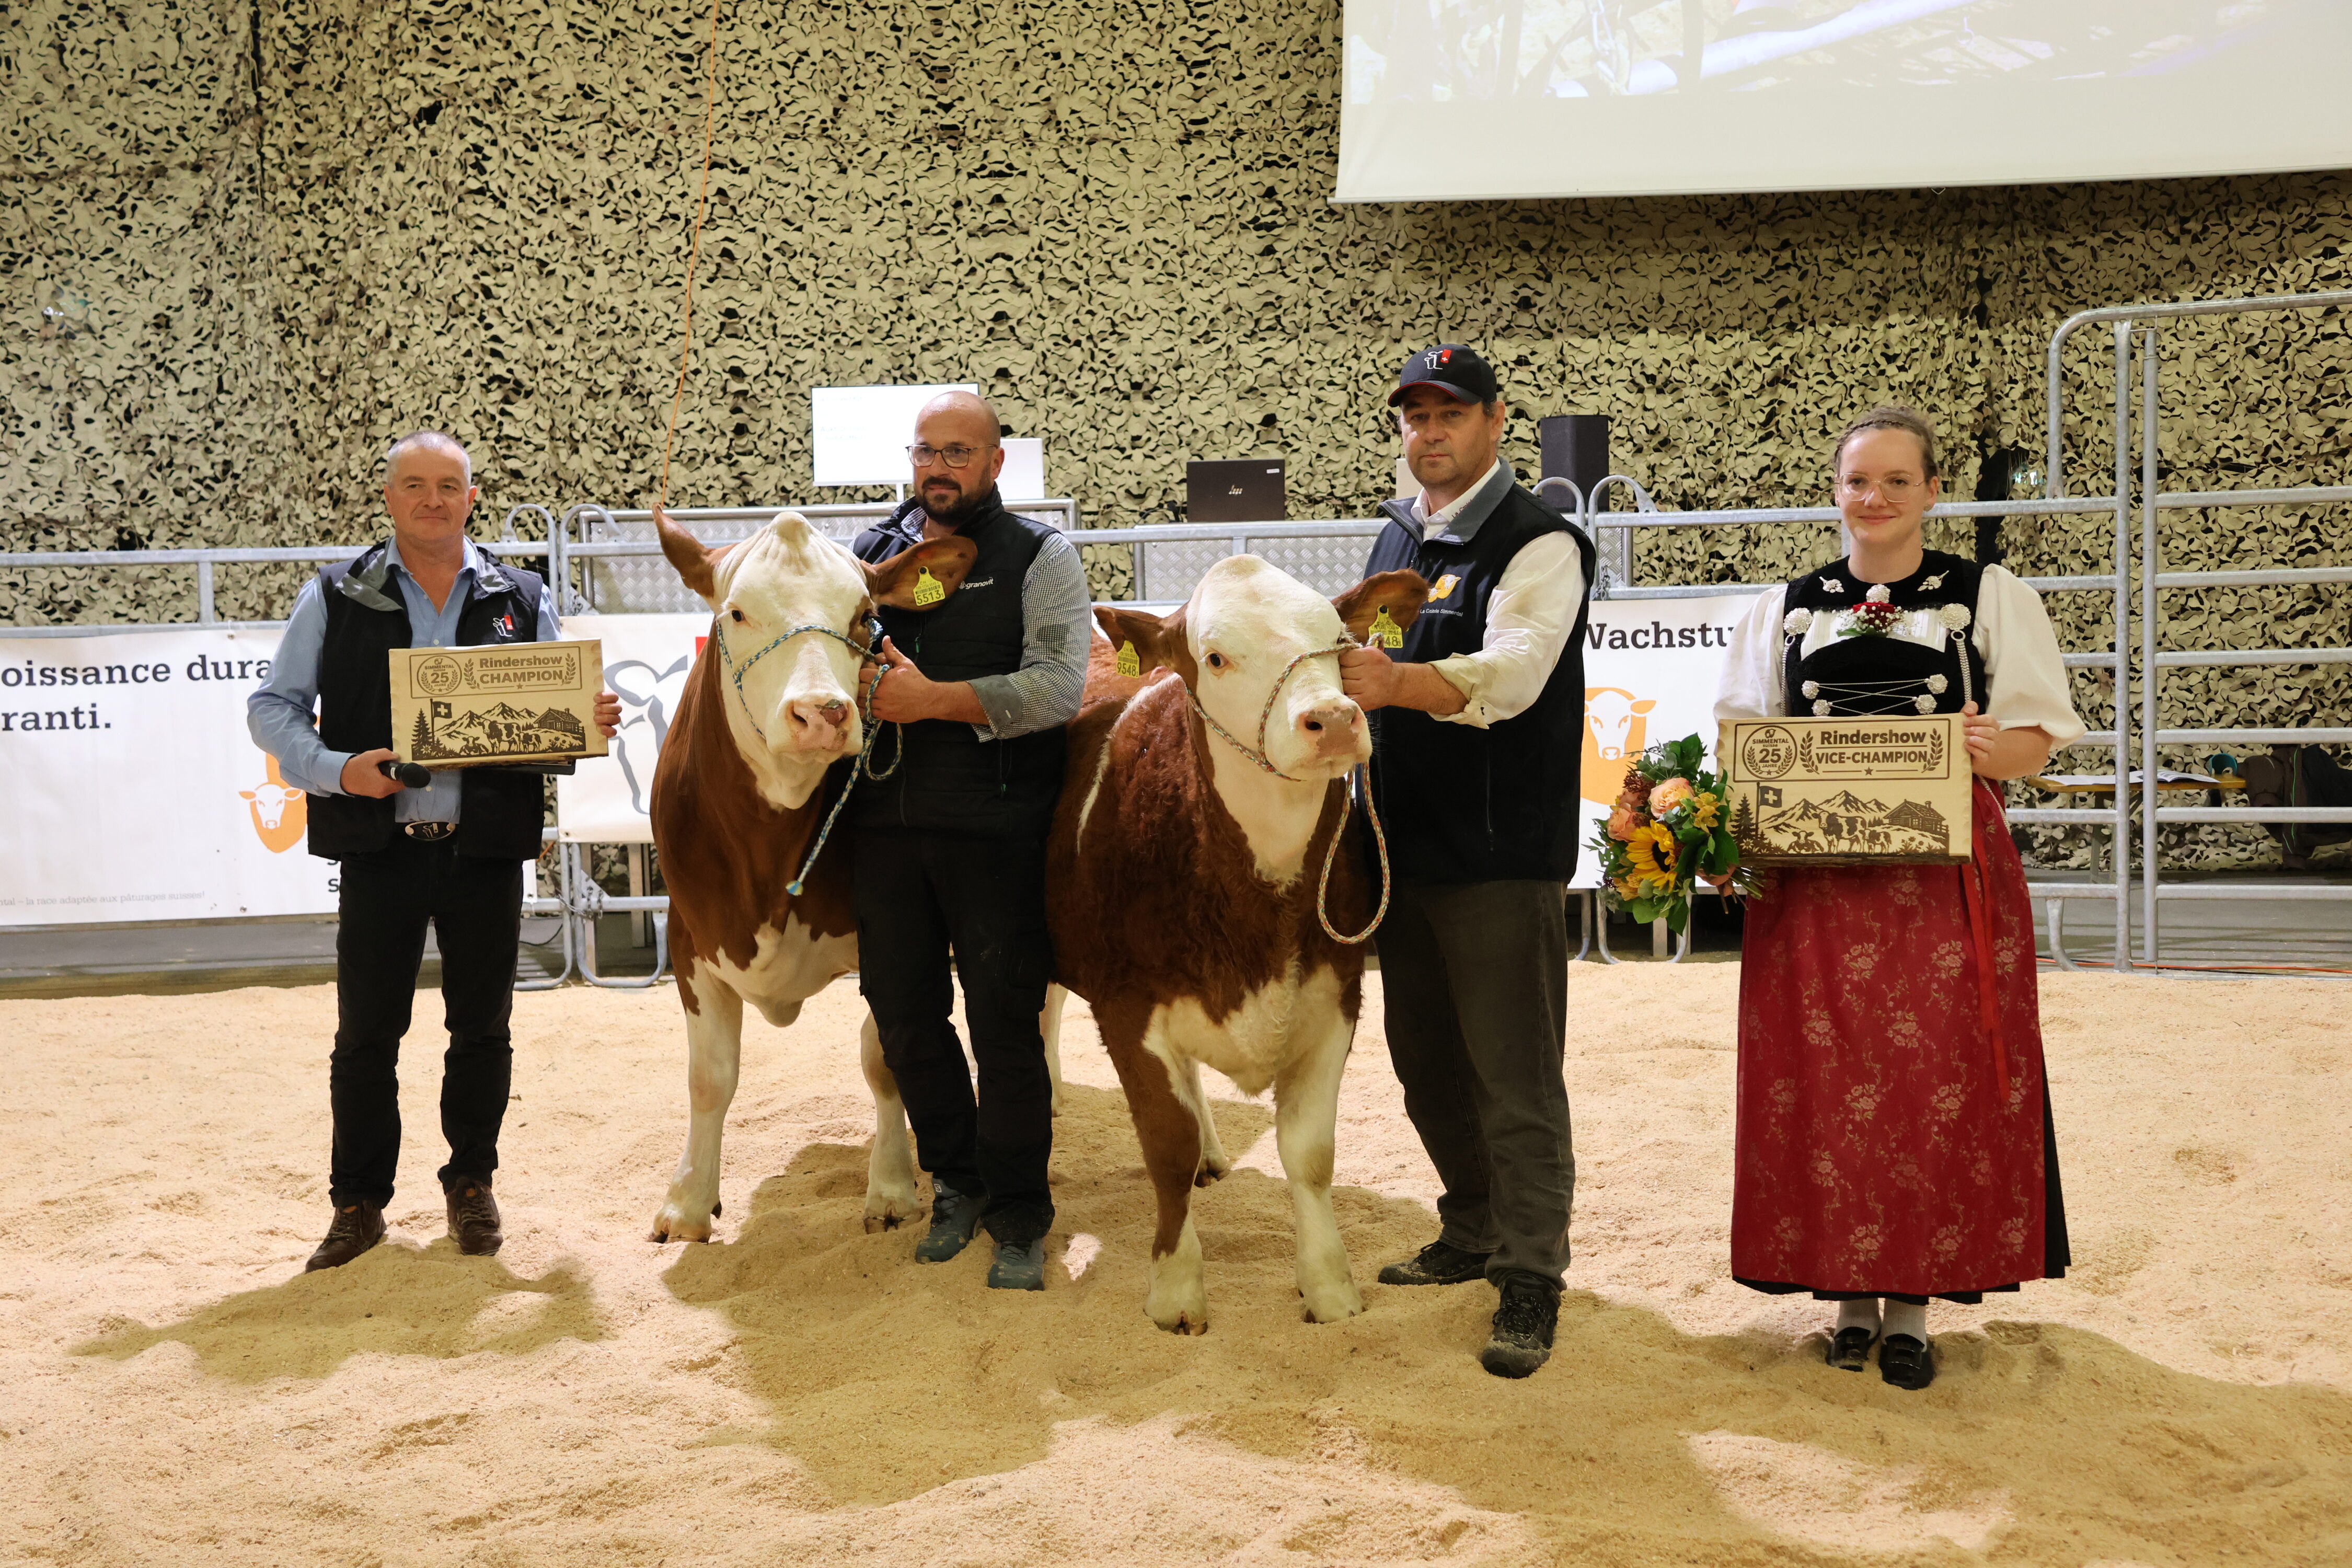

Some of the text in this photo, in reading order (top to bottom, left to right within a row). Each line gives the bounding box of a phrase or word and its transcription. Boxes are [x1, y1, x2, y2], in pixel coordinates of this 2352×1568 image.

[965, 577, 994, 590] granovit
[917, 590, 941, 604] 5513
[1439, 608, 1463, 617] Simmental
[479, 655, 562, 668] Rindershow
[1, 660, 171, 687] oissance
[1117, 662, 1136, 676] 9548
[431, 672, 449, 684] 25
[479, 670, 563, 684] CHAMPION
[1, 702, 111, 731] ranti.
[1820, 730, 1927, 745] Rindershow
[1759, 748, 1781, 763] 25
[1815, 751, 1928, 764] VICE-CHAMPION
[26, 897, 34, 905] la
[59, 895, 97, 906] adaptée
[120, 892, 166, 903] pâturages
[168, 891, 205, 900] suisses!
